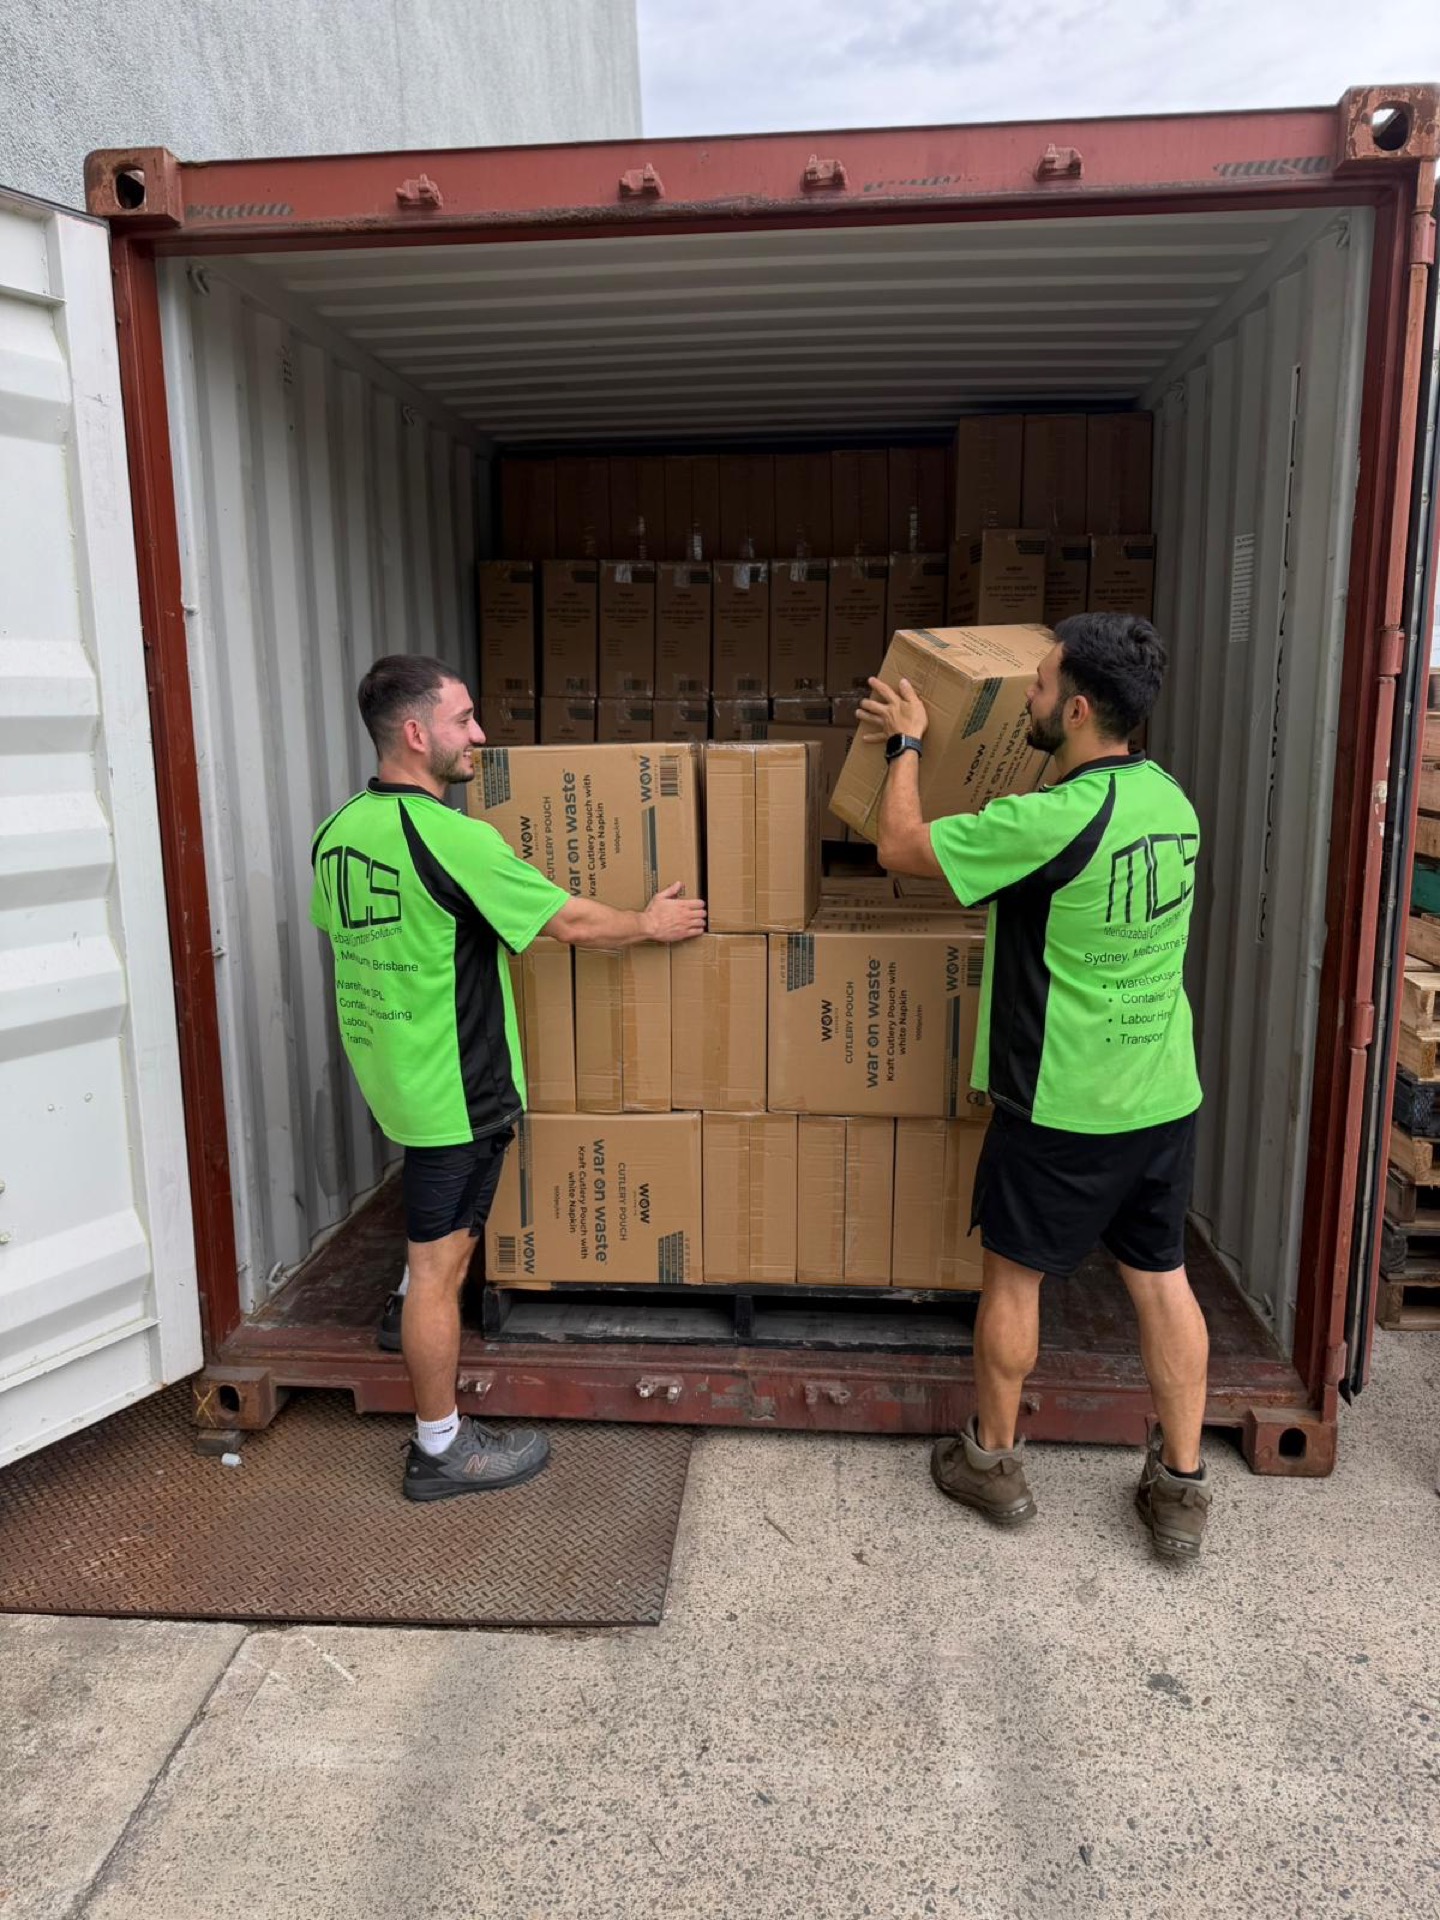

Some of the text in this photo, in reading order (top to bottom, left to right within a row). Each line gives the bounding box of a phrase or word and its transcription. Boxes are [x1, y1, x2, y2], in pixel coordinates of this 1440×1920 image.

[639, 755, 652, 802] WOW
[963, 744, 985, 785] WOW
[563, 772, 578, 833] waste
[520, 816, 533, 859] WOW
[543, 796, 555, 880] CUTLERY POUCH
[565, 838, 579, 863] on
[583, 774, 597, 897] Kraft Cutlery Pouch with
[595, 802, 607, 870] white Napkin
[372, 959, 419, 972] Brisbane
[946, 945, 959, 991] WOW
[1084, 952, 1130, 966] Sydney,
[1133, 939, 1180, 958] Melbourne
[1115, 970, 1176, 989] Warehouse
[820, 1000, 833, 1042] WOW
[845, 981, 854, 1064] CUTLERY POUCH
[865, 959, 881, 1088] war on waste
[886, 961, 897, 1082] Kraft Cutlery Pouch with
[897, 990, 909, 1055] white Napkin
[1120, 1033, 1163, 1045] Transpor
[1121, 1013, 1156, 1025] Labour
[566, 1171, 577, 1233] white Napkin
[577, 1145, 588, 1259] Kraft Cutlery Pouch with
[593, 1139, 608, 1262] war on waste
[617, 1162, 628, 1241] CUTLERY POUCH
[639, 1183, 650, 1224] WOW
[523, 1231, 535, 1275] WOW
